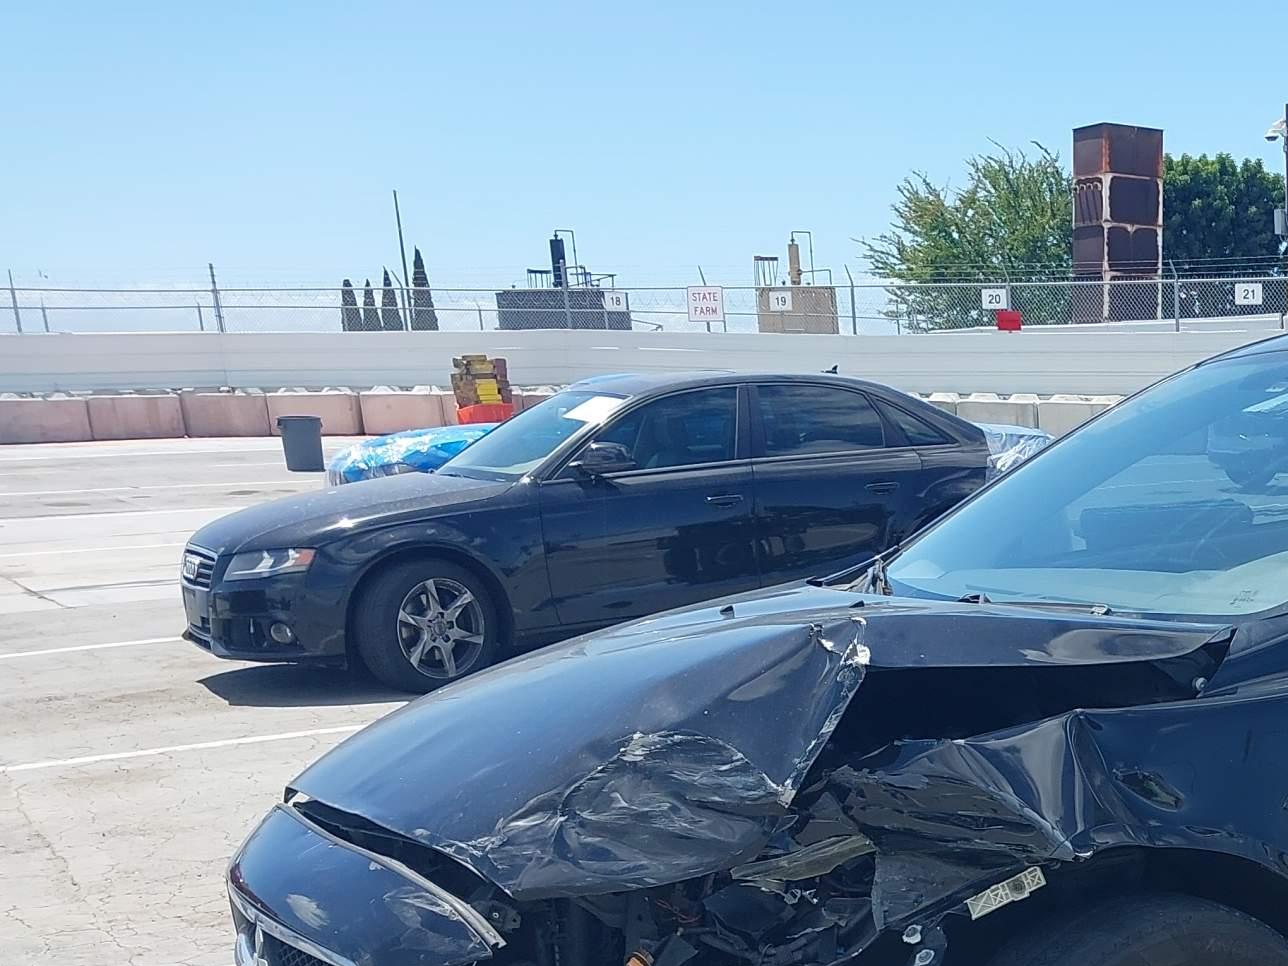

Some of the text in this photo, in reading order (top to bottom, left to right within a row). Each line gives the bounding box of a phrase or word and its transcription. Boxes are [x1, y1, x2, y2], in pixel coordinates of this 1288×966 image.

[691, 292, 719, 302] STATE
[988, 294, 1001, 304] 20
[1243, 288, 1255, 300] 21
[610, 295, 621, 306] 18
[775, 296, 786, 306] 19
[694, 306, 717, 316] FARM
